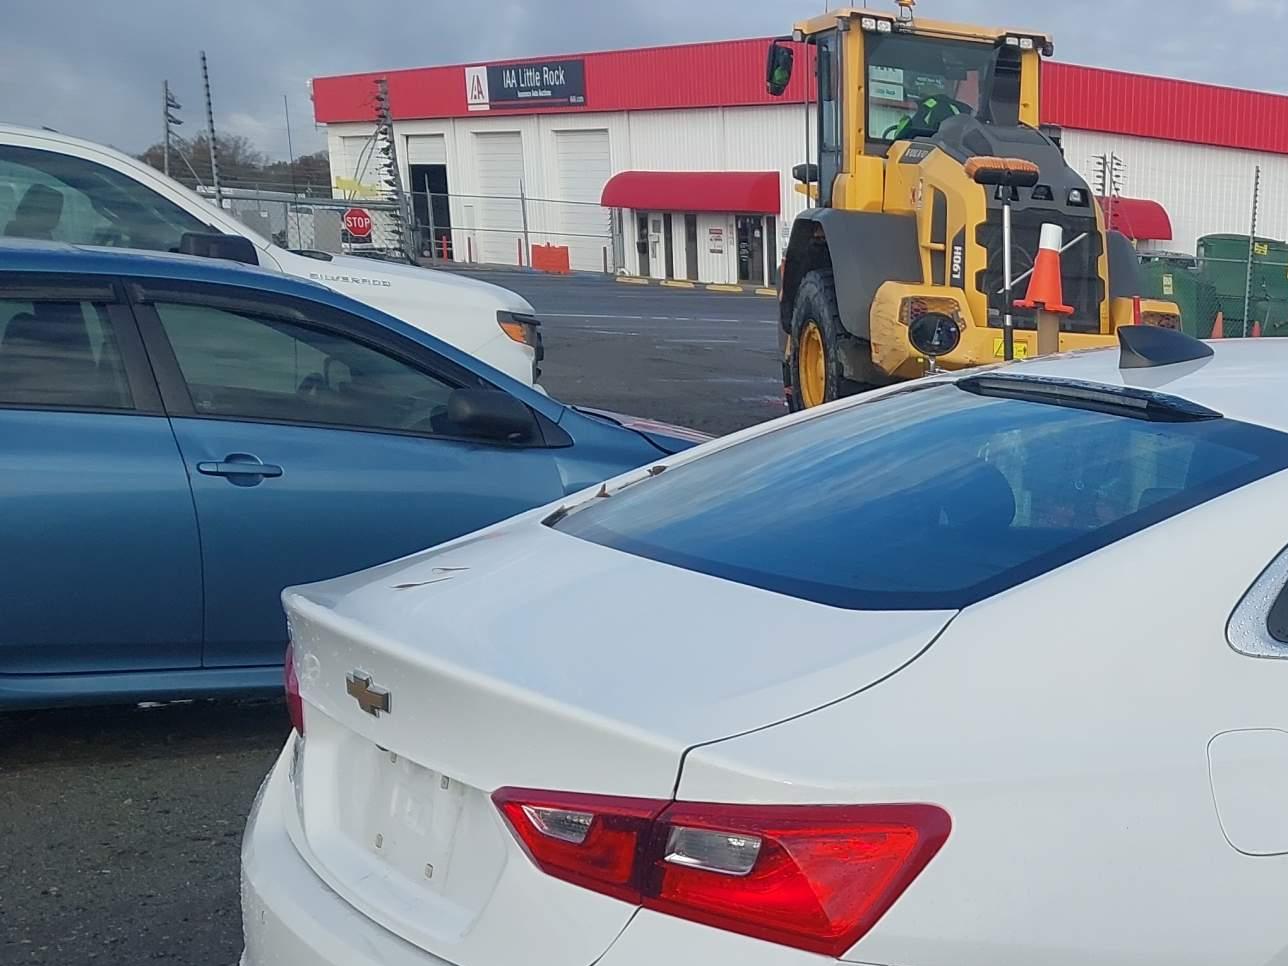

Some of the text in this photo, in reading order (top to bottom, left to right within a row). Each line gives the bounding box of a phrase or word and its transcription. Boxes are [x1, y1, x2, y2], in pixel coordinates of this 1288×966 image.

[503, 65, 565, 88] IAA Little Rock
[346, 216, 370, 229] STOP
[952, 245, 962, 279] L90H
